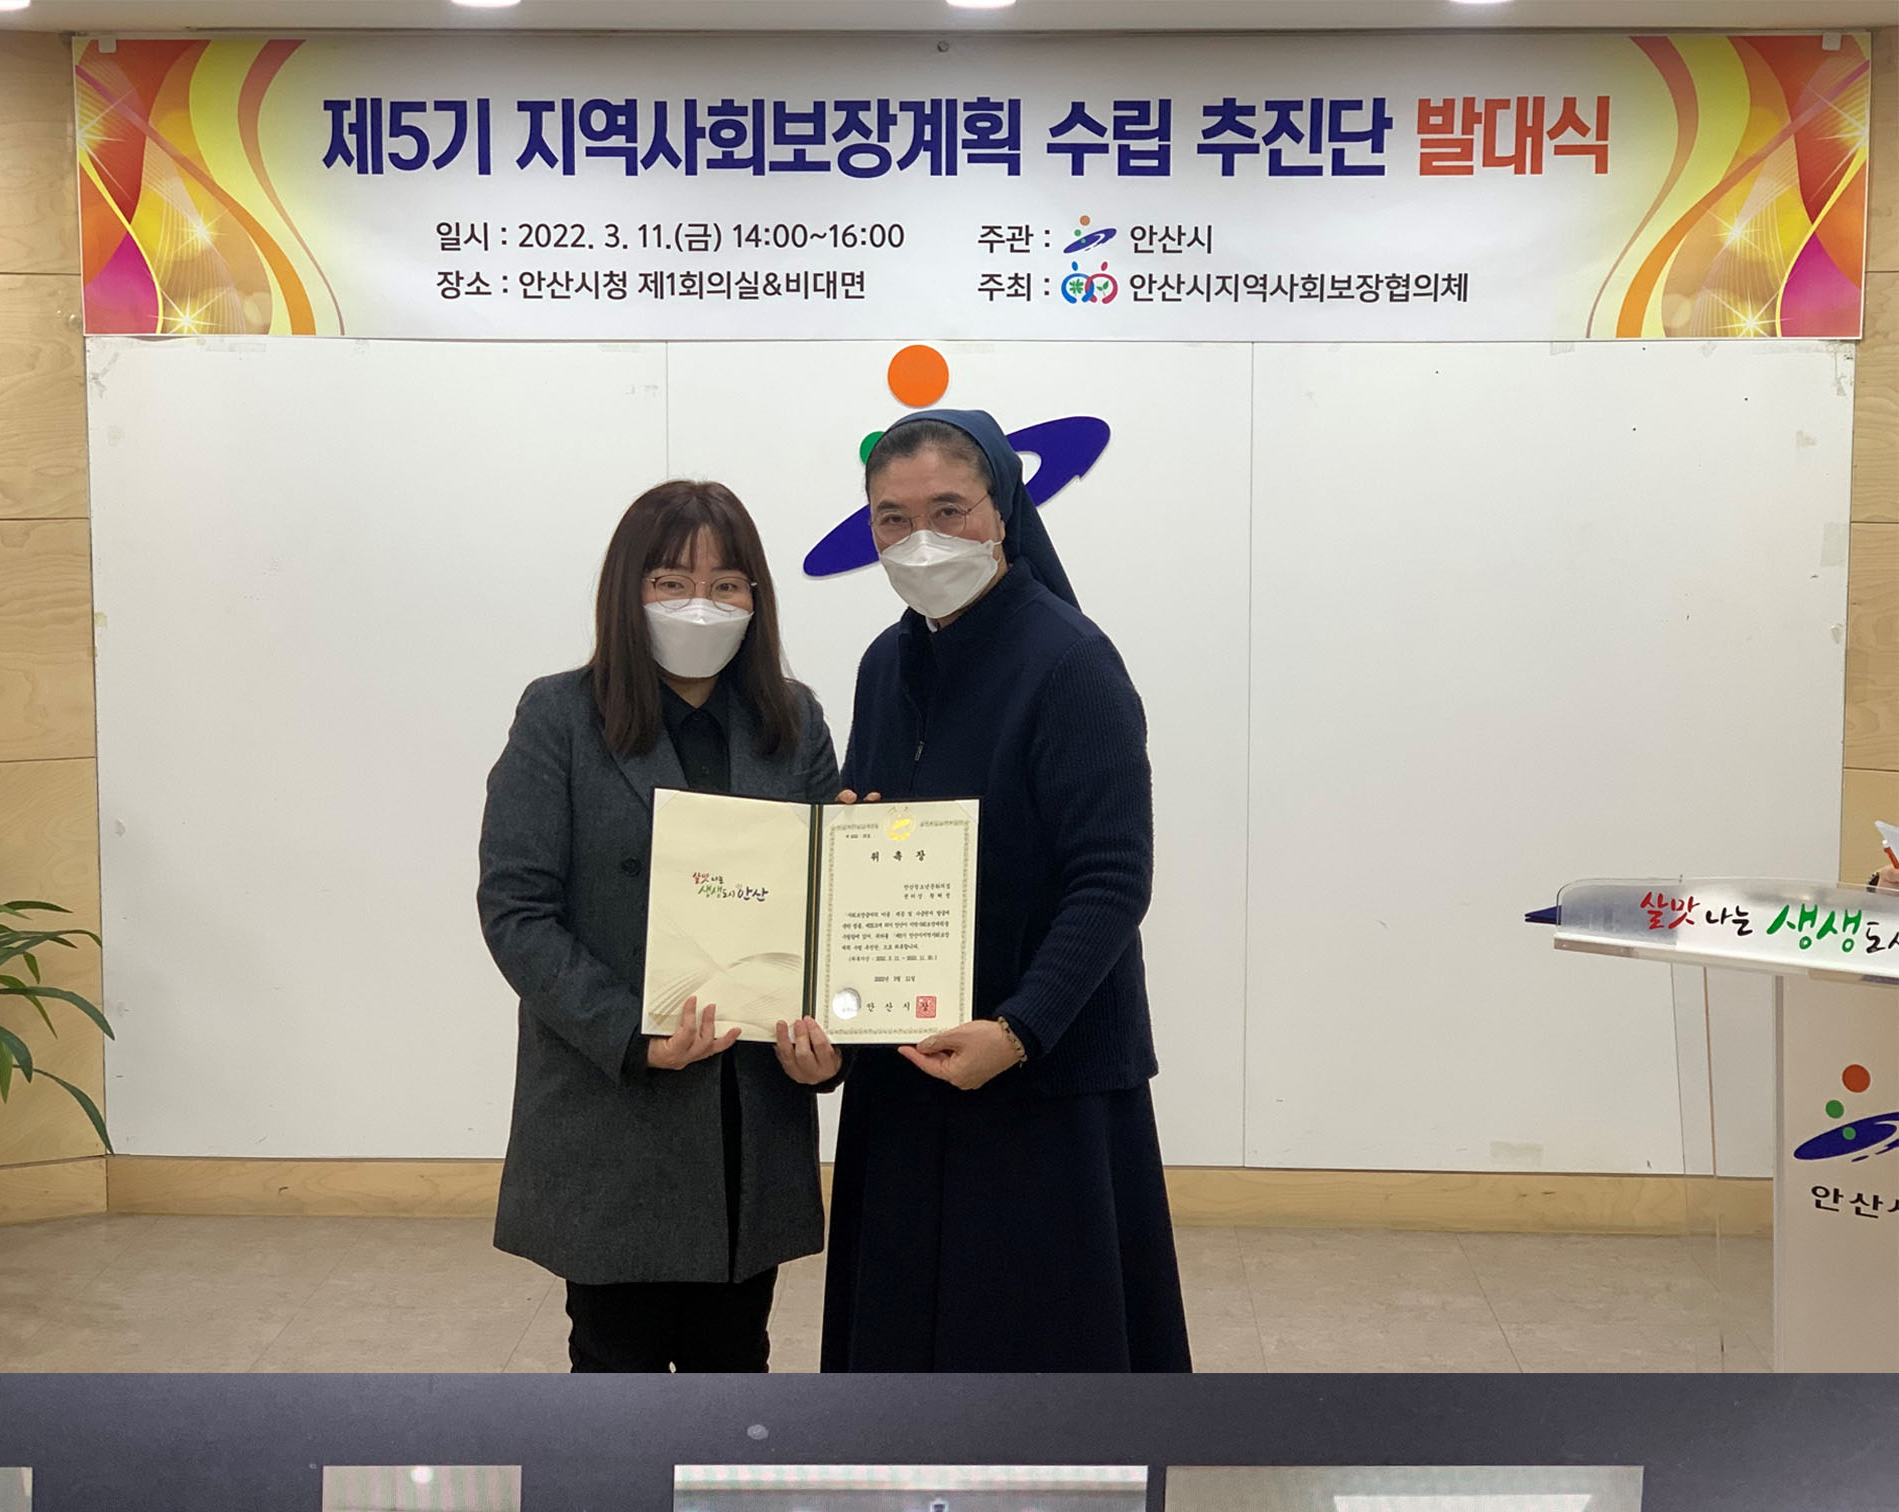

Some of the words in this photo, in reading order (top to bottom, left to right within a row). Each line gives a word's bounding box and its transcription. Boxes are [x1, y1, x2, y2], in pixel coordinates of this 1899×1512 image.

[322, 98, 490, 177] 제5기
[516, 97, 1023, 178] 지역사회보장계획
[1045, 98, 1172, 178] 수립
[1196, 96, 1393, 177] 추진단
[1415, 94, 1611, 176] 발대식
[436, 221, 491, 252] 일시
[518, 222, 595, 252] 2022.
[604, 222, 629, 251] 3.
[637, 221, 724, 255] 11.(금)
[732, 222, 905, 251] 14:00~16:00
[977, 224, 1033, 255] 주관
[1129, 224, 1214, 254] 안산시
[436, 270, 494, 302] 장소
[518, 270, 629, 301] 안산시청
[637, 269, 867, 303] 제1회의실&비대면
[977, 272, 1033, 303] 주최
[1129, 271, 1469, 303] 안산시지역사회보장협의체
[1640, 891, 1701, 930] 살맛
[1706, 905, 1753, 935] 나는
